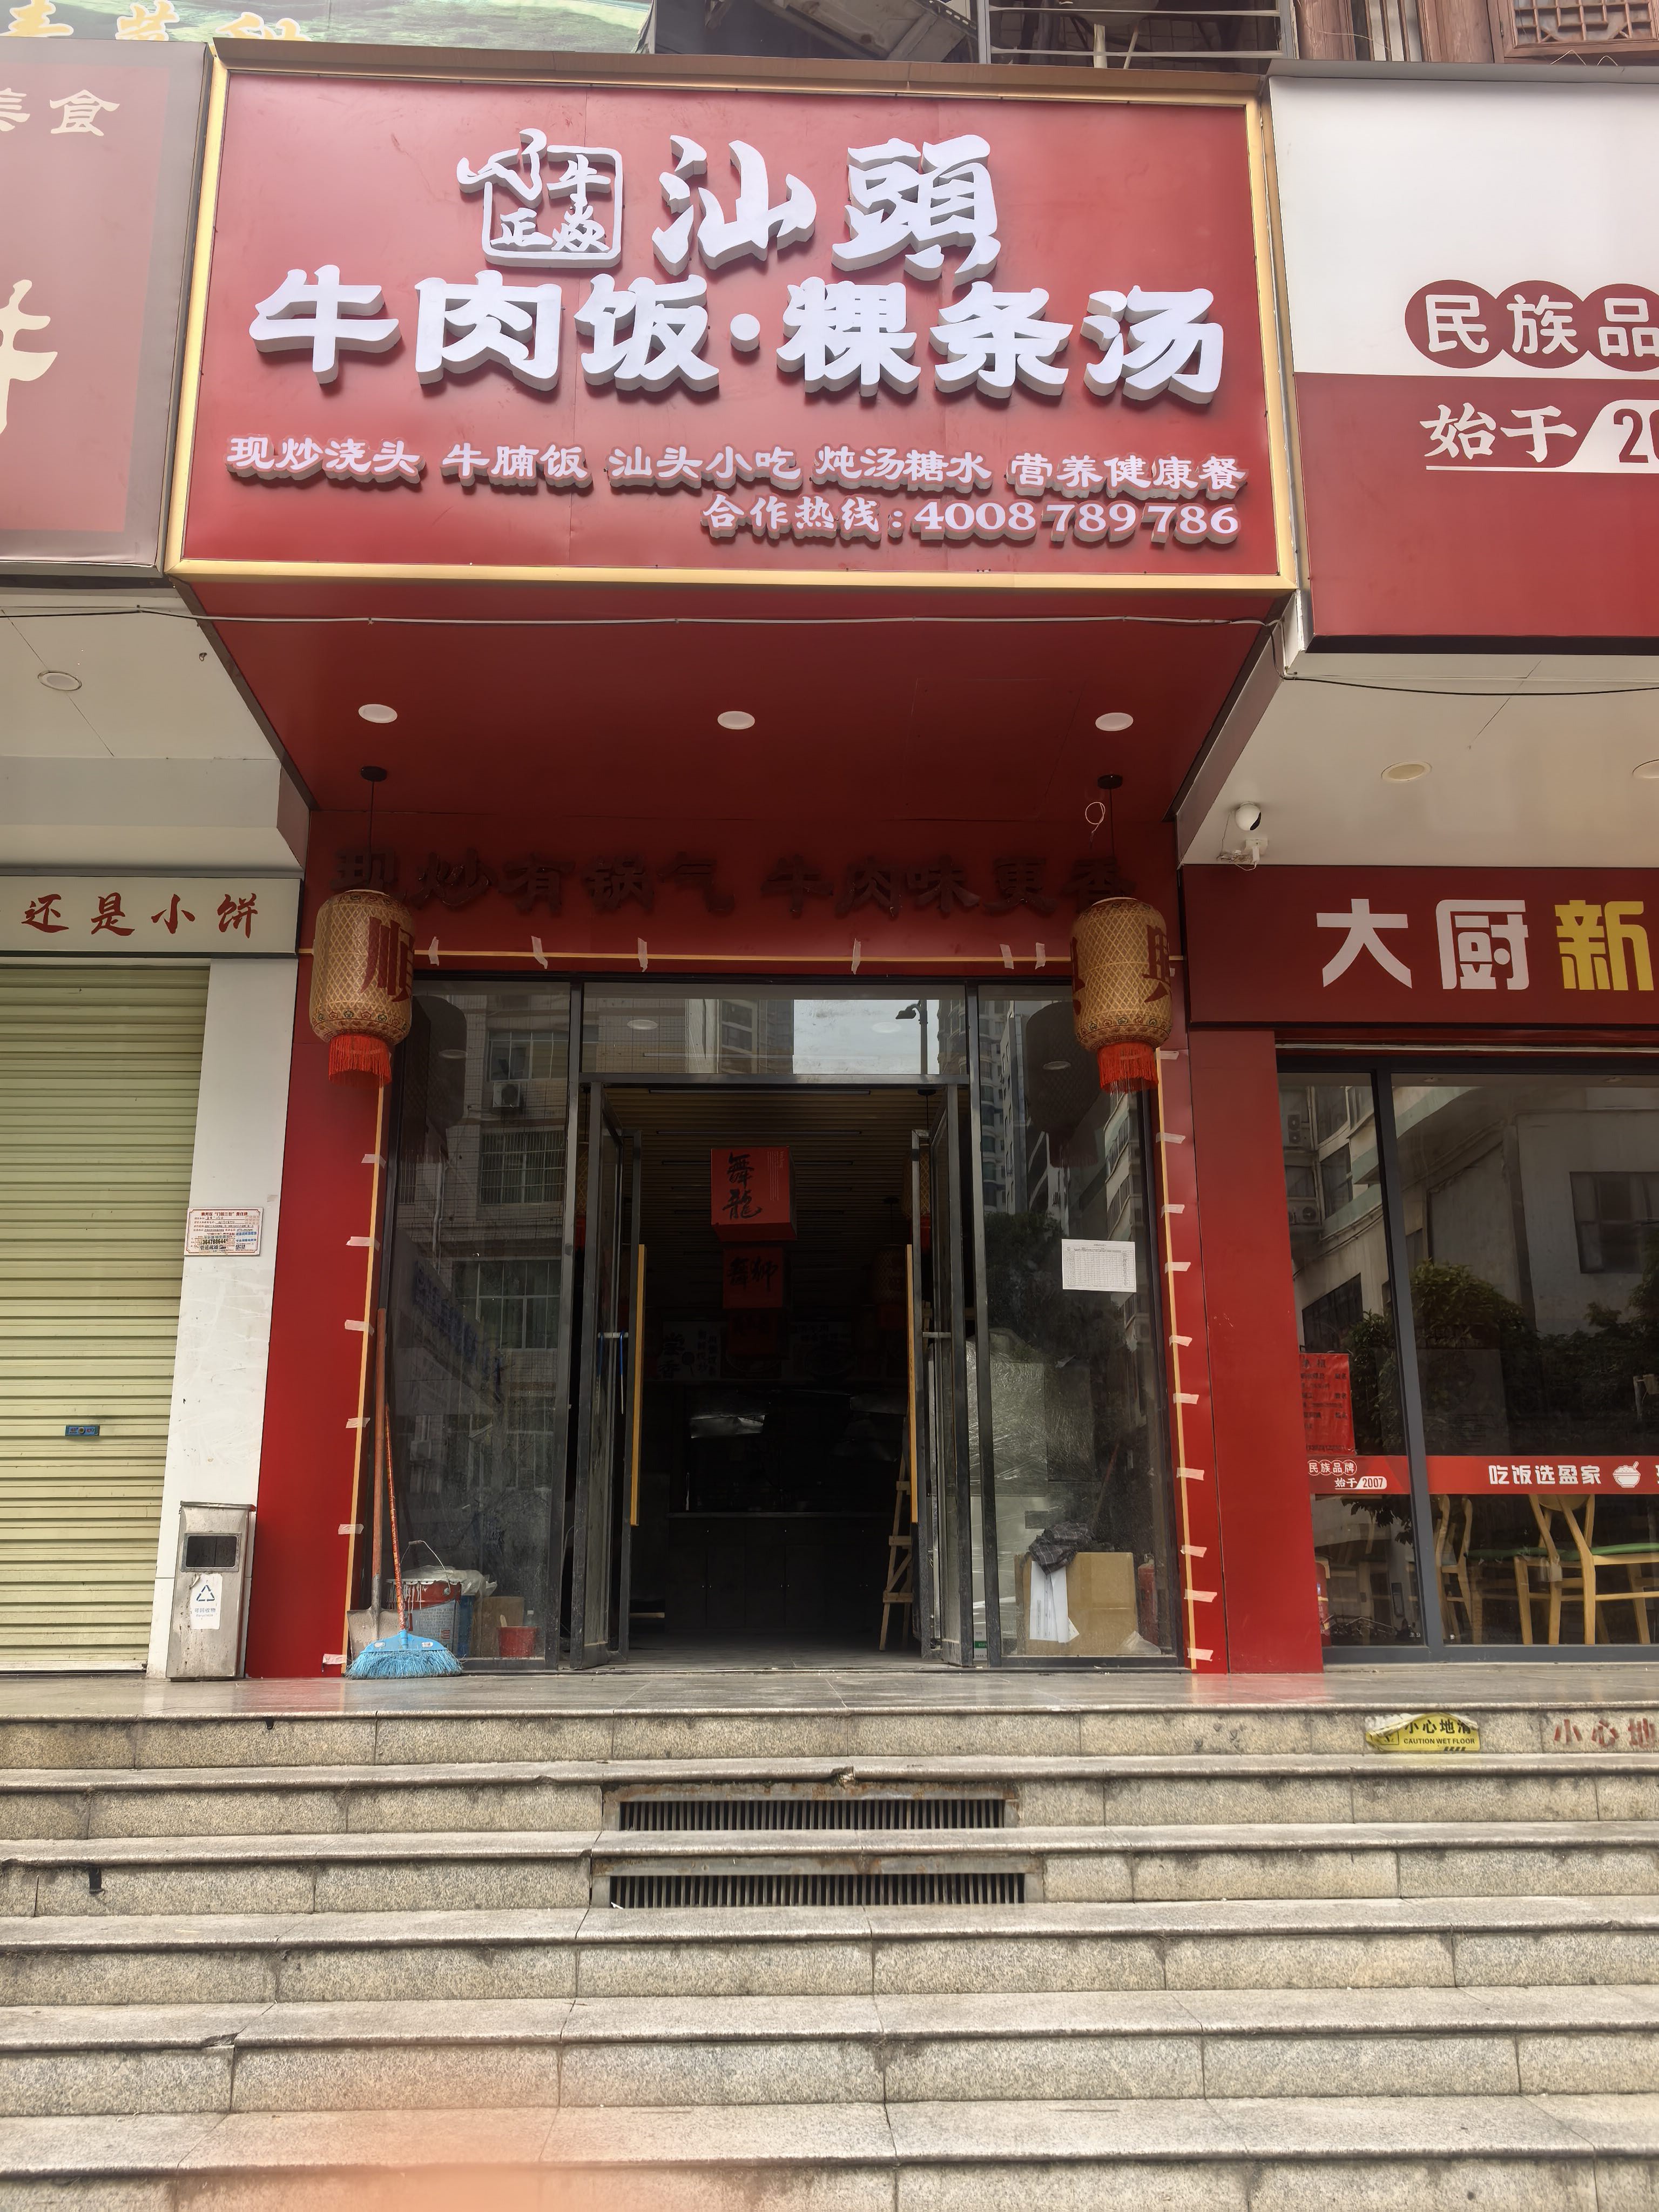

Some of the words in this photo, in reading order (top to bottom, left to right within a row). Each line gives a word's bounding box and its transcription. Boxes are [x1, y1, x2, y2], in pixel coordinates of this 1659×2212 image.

[249, 264, 1224, 404] 牛肉饭·粿条汤
[1425, 294, 1659, 357] 民族品
[1419, 402, 1577, 463] 始于
[225, 434, 427, 484] 现炒浇头
[440, 442, 594, 488] 牛腩饭
[605, 444, 803, 490] 汕头小吃
[812, 445, 993, 494] 炖汤糖水
[1007, 452, 1248, 500] 营养健康餐
[22, 892, 258, 939] 还是小饼
[1316, 898, 1656, 992] 大厨新
[1309, 1462, 1355, 1474] 民族品牌
[1334, 1477, 1358, 1489] 始于
[1362, 1478, 1384, 1488] 2007
[1488, 1465, 1602, 1485] 吃饭选盈家
[1553, 1717, 1656, 1749] 小心地
